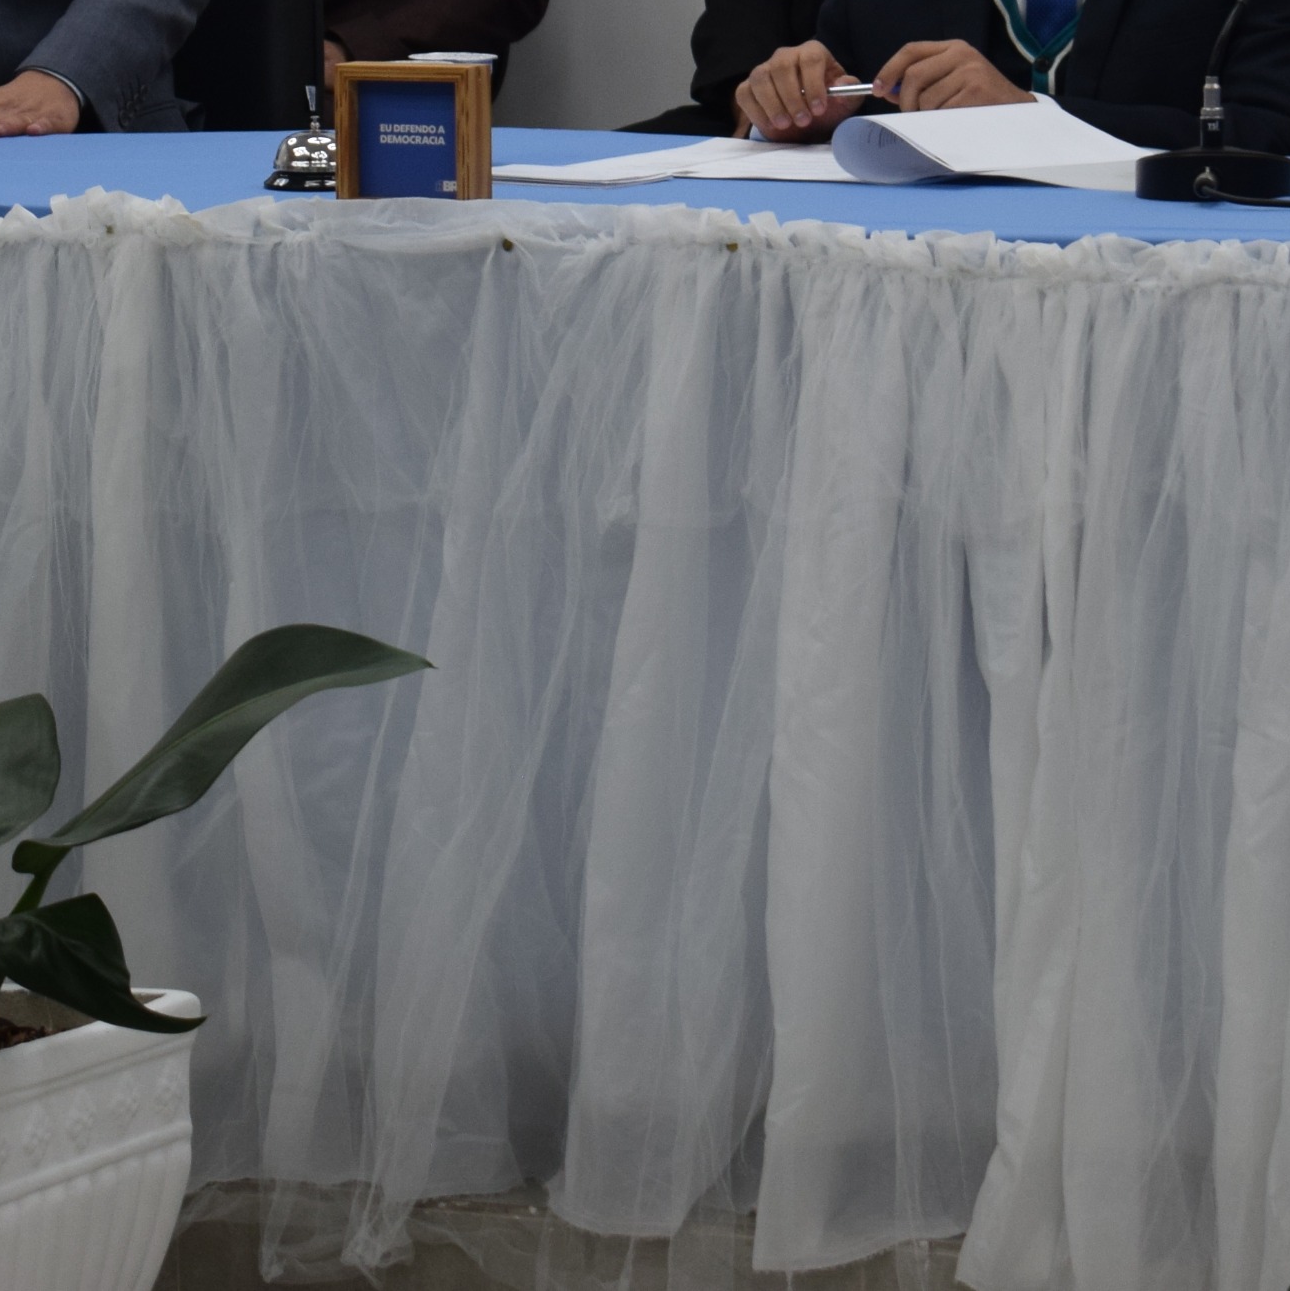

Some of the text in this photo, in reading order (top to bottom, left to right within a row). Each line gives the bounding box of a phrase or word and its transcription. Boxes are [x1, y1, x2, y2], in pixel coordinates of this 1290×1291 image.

[379, 123, 446, 135] EU DEFENDO A
[379, 134, 446, 146] DEMOCRACIA
